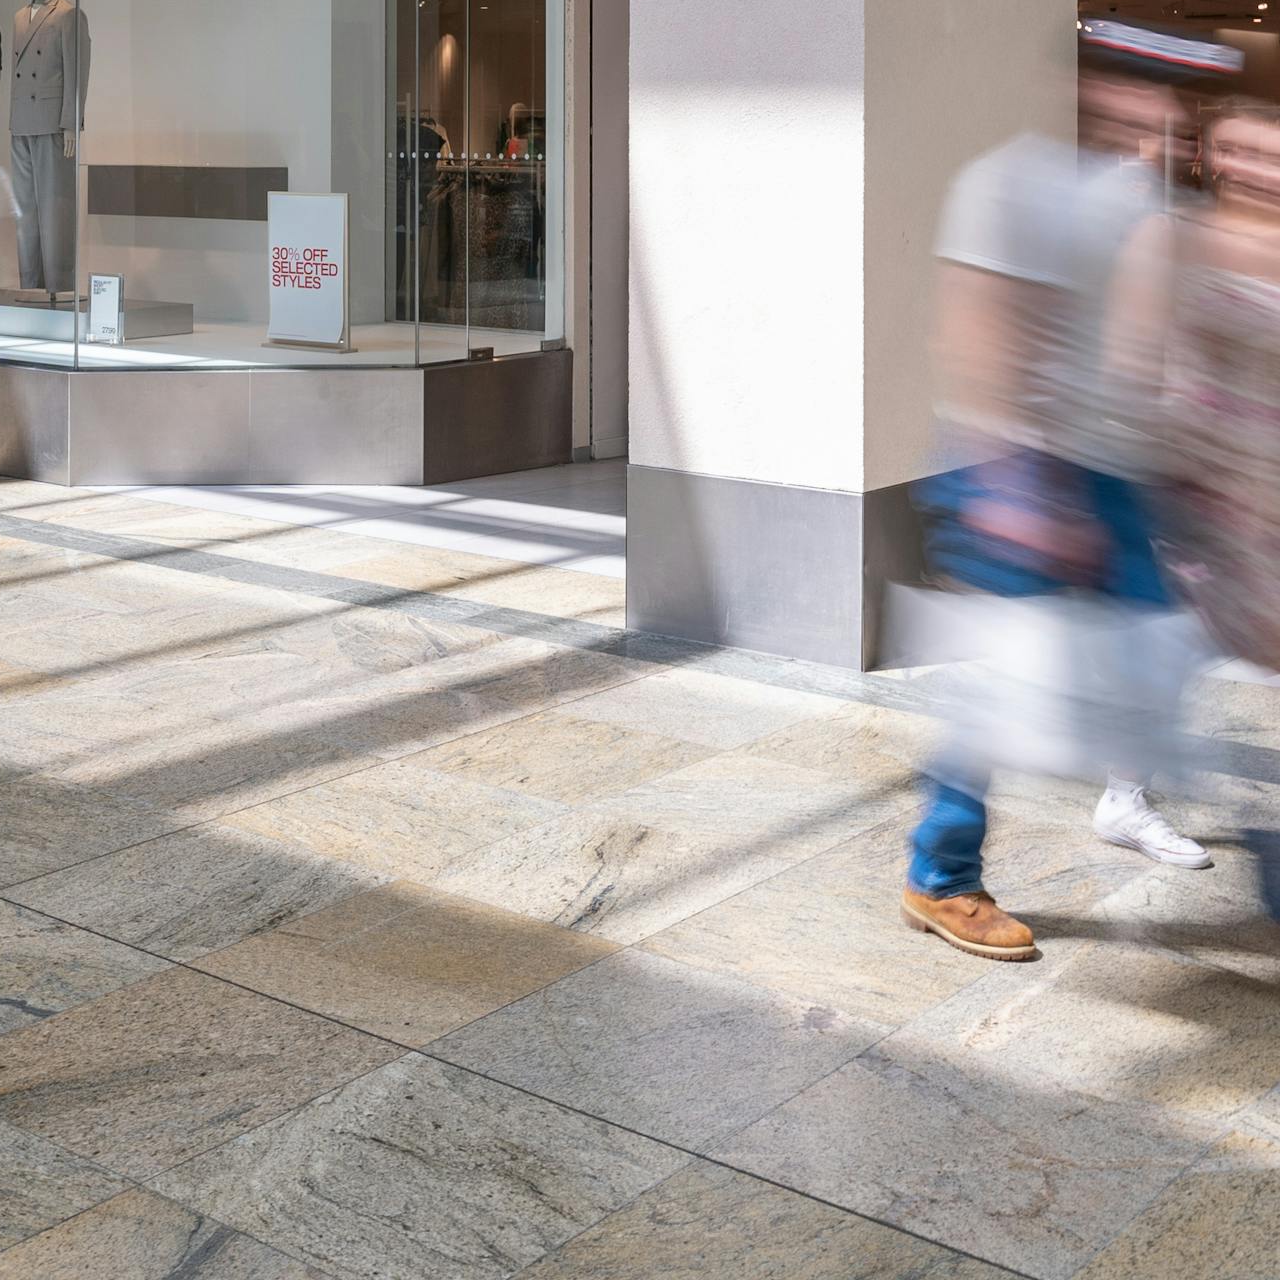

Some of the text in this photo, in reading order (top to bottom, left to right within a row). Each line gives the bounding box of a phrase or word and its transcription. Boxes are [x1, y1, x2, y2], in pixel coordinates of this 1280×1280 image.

[272, 247, 328, 262] 30% OFF
[272, 260, 338, 276] SELECTED
[272, 274, 321, 289] STYLES
